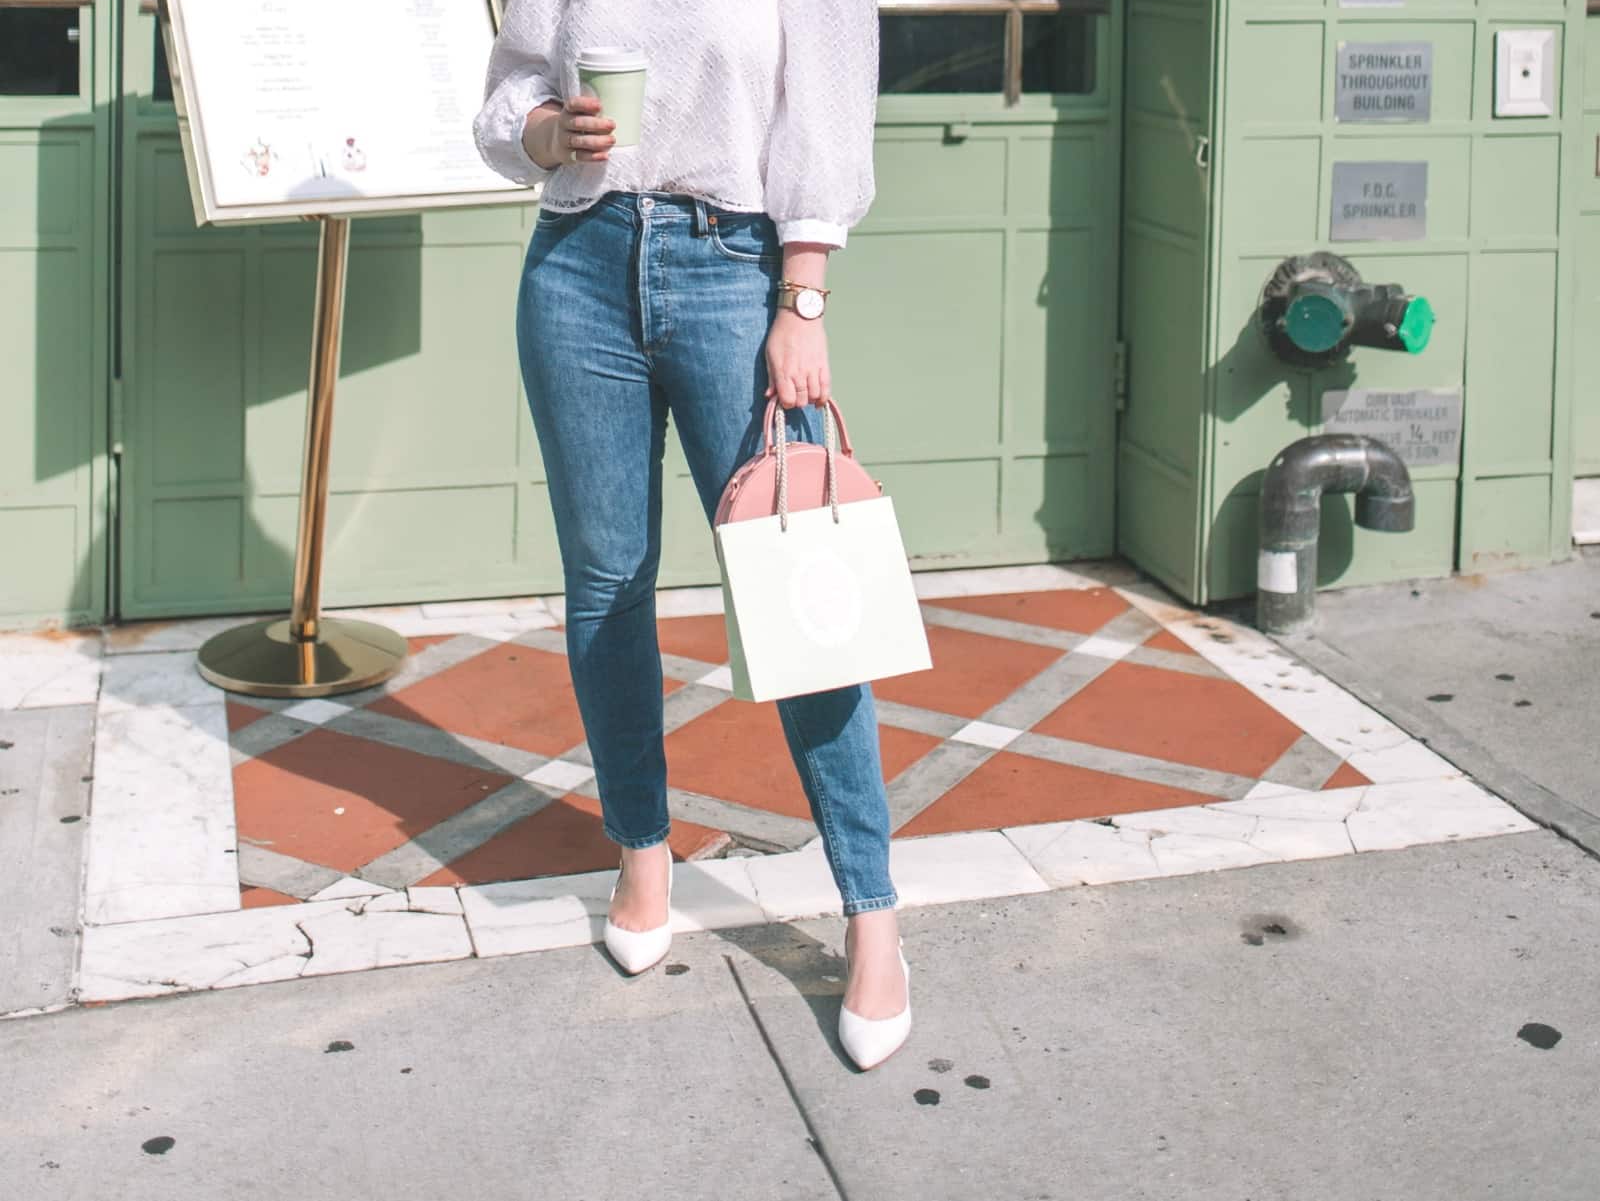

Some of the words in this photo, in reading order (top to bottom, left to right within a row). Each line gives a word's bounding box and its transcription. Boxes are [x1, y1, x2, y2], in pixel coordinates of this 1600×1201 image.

[1348, 54, 1423, 70] SPRINKLER
[1341, 74, 1429, 90] THROUGHOUT
[1352, 95, 1416, 111] BUILDING
[1342, 204, 1417, 220] SPRINKLER
[1334, 408, 1390, 423] AUTOMATIC
